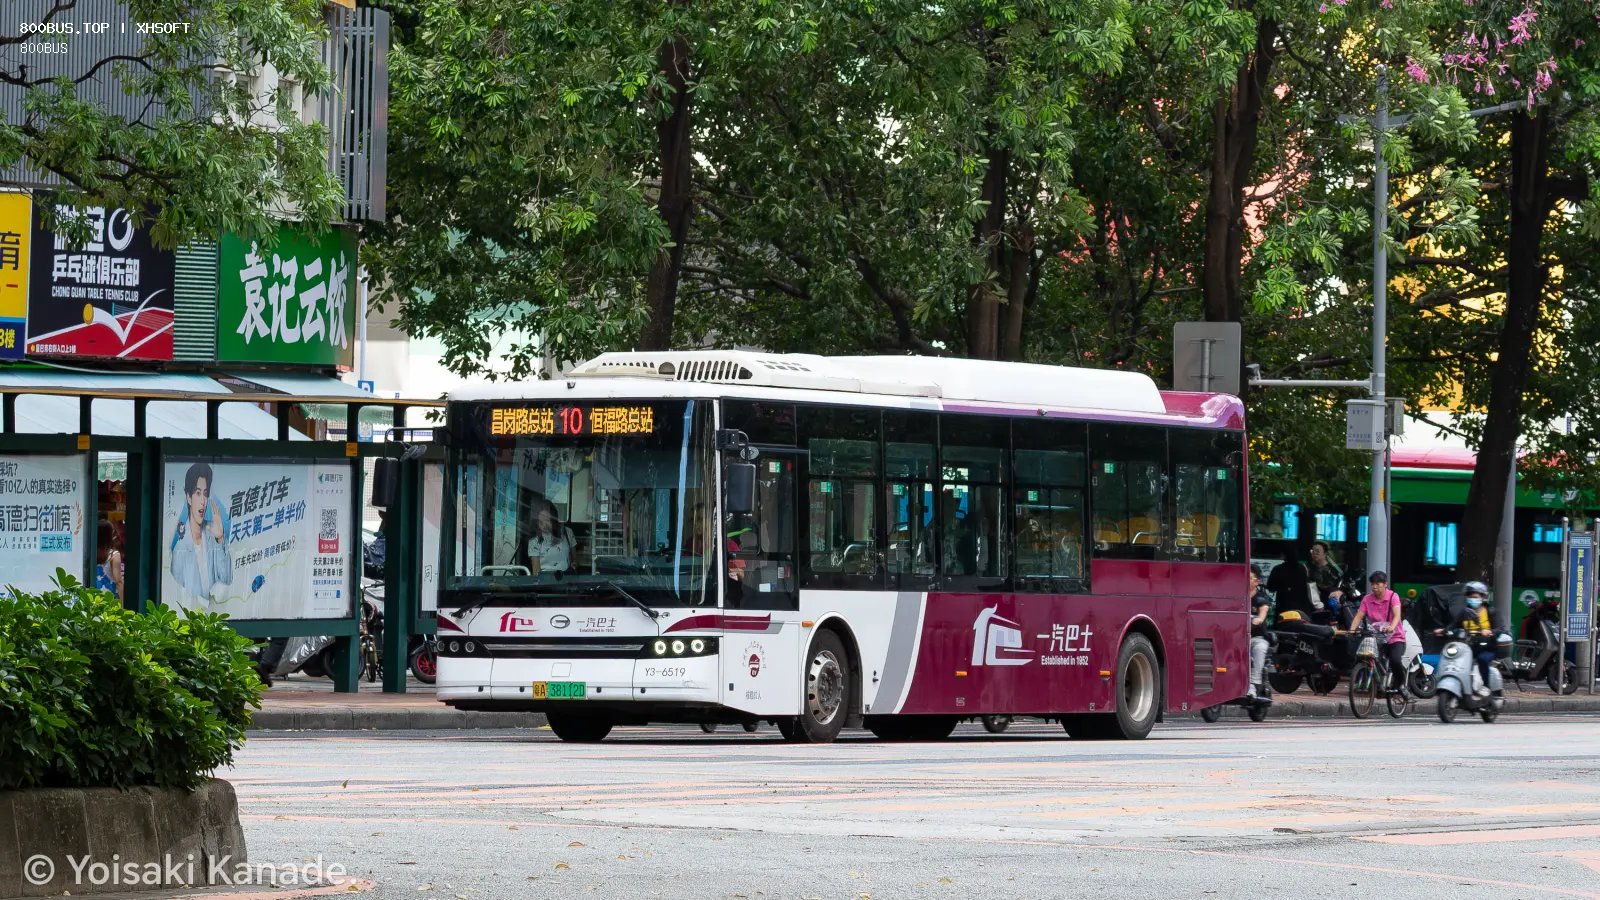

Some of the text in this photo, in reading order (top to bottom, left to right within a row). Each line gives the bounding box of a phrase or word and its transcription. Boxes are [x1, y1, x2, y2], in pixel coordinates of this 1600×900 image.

[52, 254, 140, 287] 乒乓球俱乐部
[52, 286, 139, 302] CHONG GUAN TABLE TENNIS CLUB
[236, 241, 348, 350] 袁记云饺
[491, 407, 653, 435] 昌岗路总站 10 恒福路总站
[229, 475, 292, 521] 高德打车
[229, 500, 307, 545] 天天第二单半价
[41, 535, 71, 549] 正式发布
[576, 617, 617, 628] 一汽巴士
[1036, 623, 1094, 652] 一汽巴士
[645, 667, 686, 677] Y3-6519
[1041, 655, 1089, 666] Established in 1952
